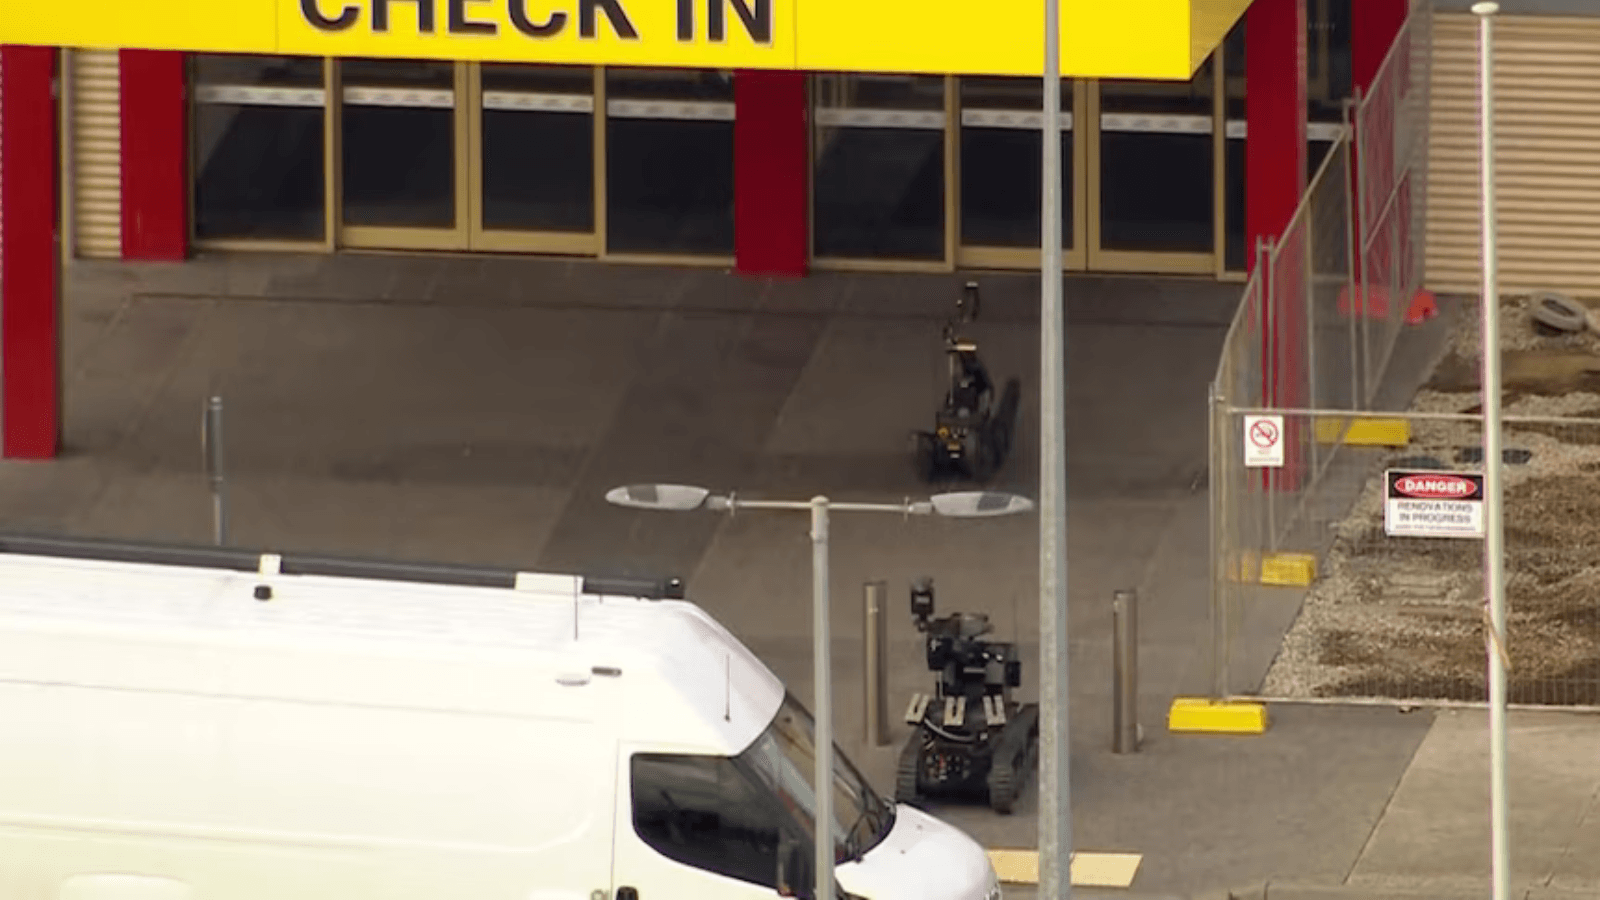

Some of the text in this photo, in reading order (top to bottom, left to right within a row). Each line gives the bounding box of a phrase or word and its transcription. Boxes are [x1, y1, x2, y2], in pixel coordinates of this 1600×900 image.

[299, 0, 773, 44] CHECK IN
[1404, 478, 1467, 494] DANGER
[1397, 502, 1474, 513] RENOVATIONS
[1399, 513, 1471, 524] IN PROGRESS
